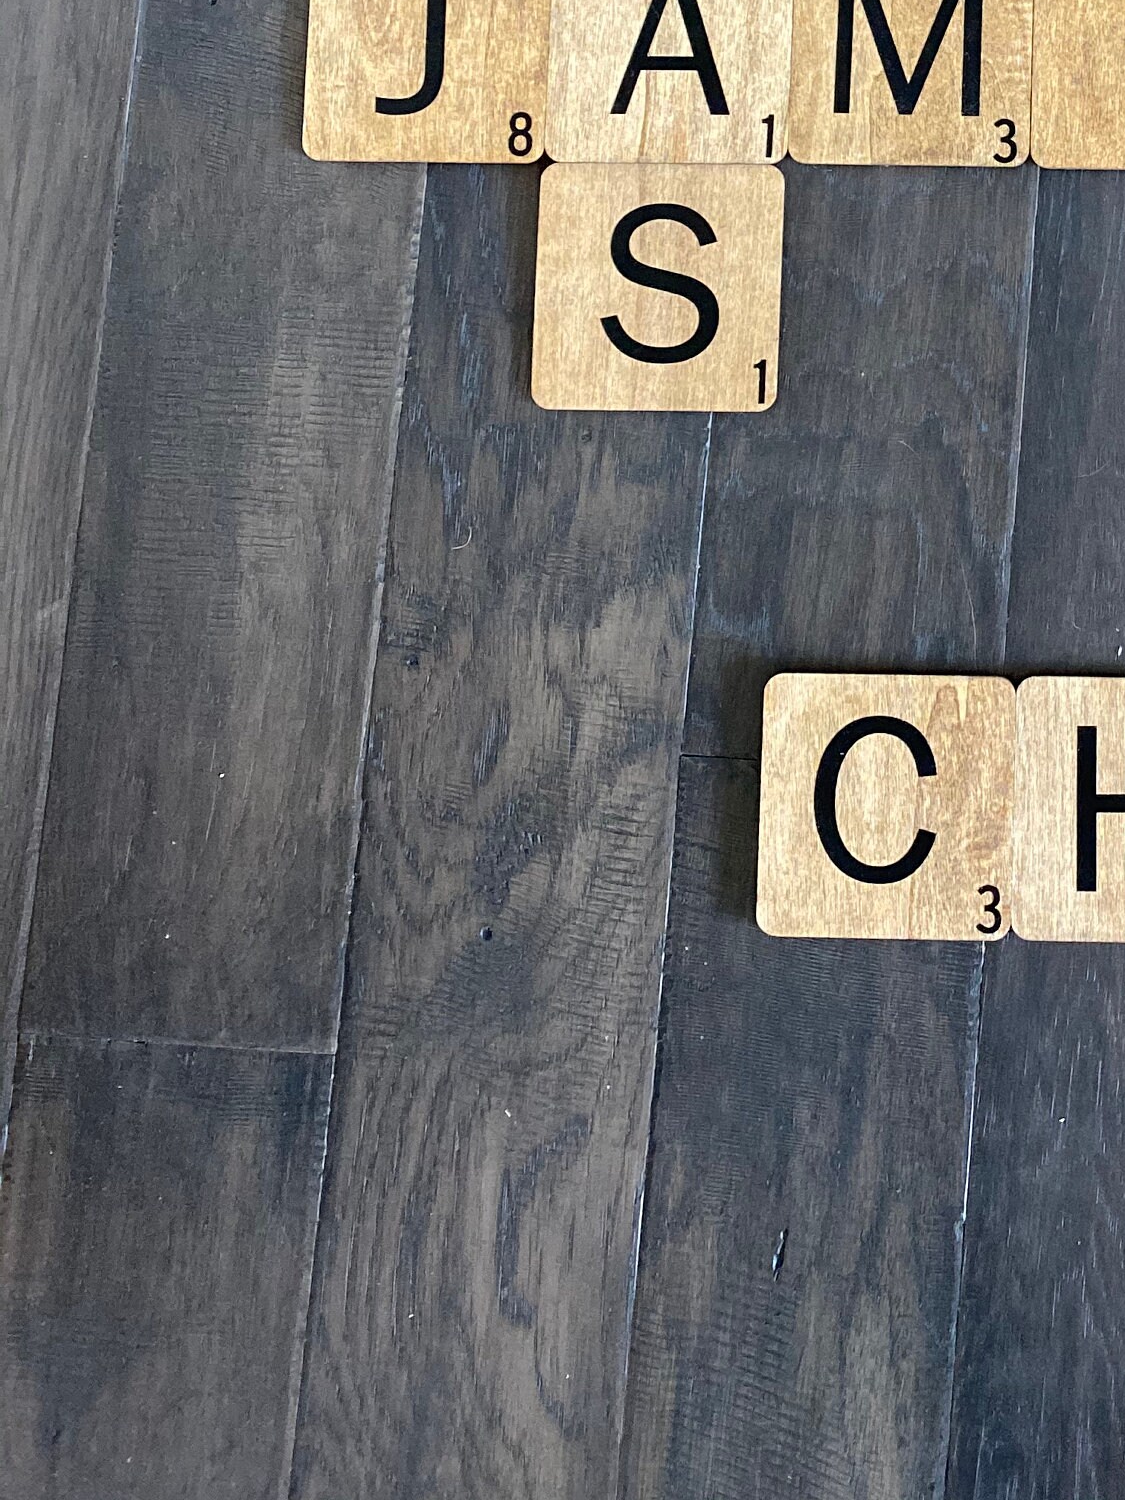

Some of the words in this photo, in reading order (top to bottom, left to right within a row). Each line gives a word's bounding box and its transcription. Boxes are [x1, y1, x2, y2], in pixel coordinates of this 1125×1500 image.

[509, 112, 532, 156] 8
[762, 115, 774, 157] 1
[993, 119, 1017, 163] 3
[754, 360, 766, 404] 1
[976, 885, 1001, 933] 3
